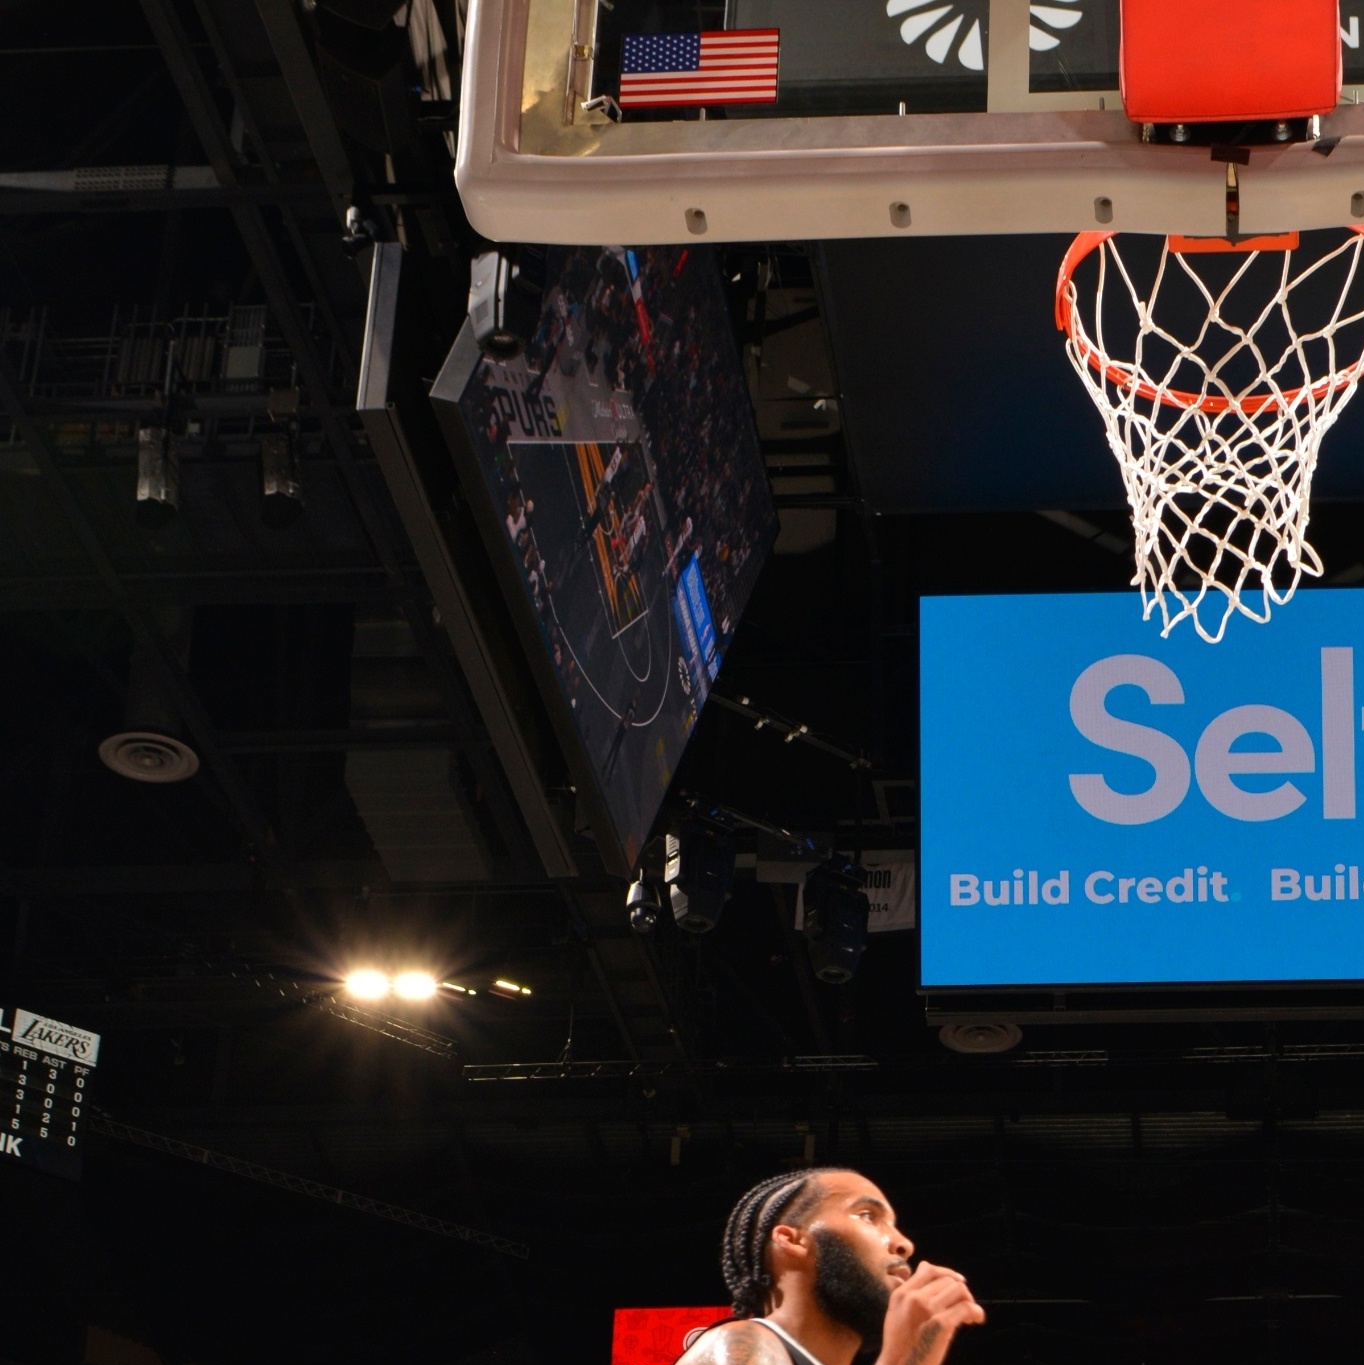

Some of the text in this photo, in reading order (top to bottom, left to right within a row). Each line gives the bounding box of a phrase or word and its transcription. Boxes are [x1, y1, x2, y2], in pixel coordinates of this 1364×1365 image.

[950, 868, 1070, 906] Build
[20, 1018, 91, 1059] LAKERS
[14, 1046, 38, 1061] REB
[42, 1056, 67, 1070] AST
[74, 1065, 91, 1077] PF
[18, 1074, 83, 1103] 3 0 0
[49, 1069, 58, 1080] 3
[76, 1078, 85, 1088] 0
[16, 1089, 80, 1117] 3 0 0
[42, 1113, 50, 1123] 2
[11, 1119, 76, 1146] 5 5 0
